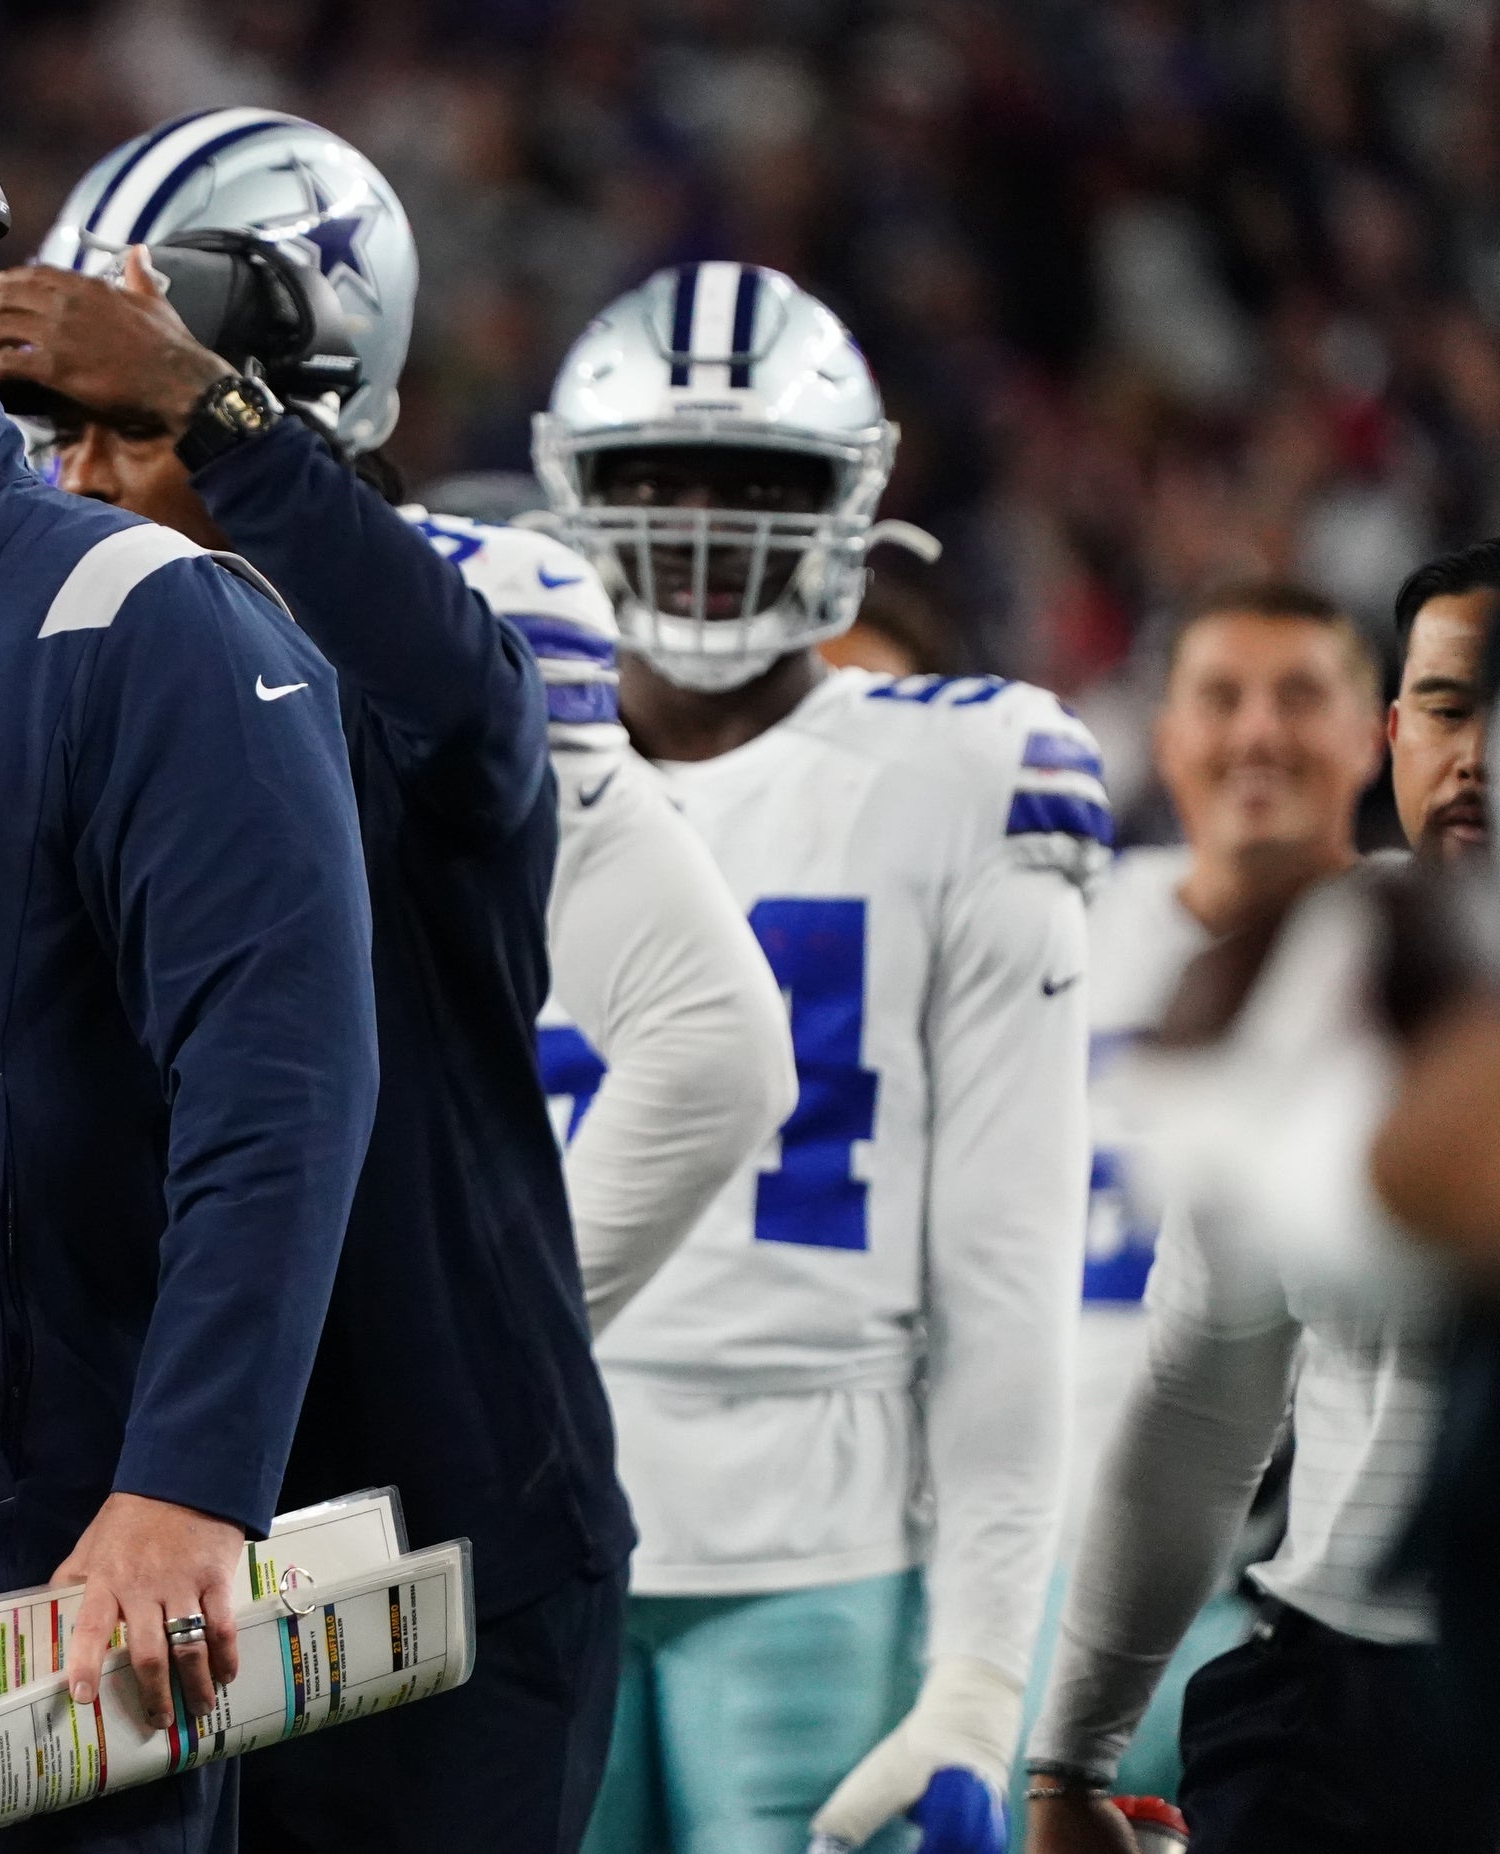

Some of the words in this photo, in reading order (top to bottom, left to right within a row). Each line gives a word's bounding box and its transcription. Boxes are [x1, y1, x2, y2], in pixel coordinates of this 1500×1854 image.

[391, 1604, 400, 1639] JUMBO
[326, 1615, 337, 1662] BUFFALO
[393, 1641, 401, 1654] 23
[291, 1635, 301, 1664] BASE
[295, 1672, 303, 1685] 22
[332, 1670, 339, 1681] 22
